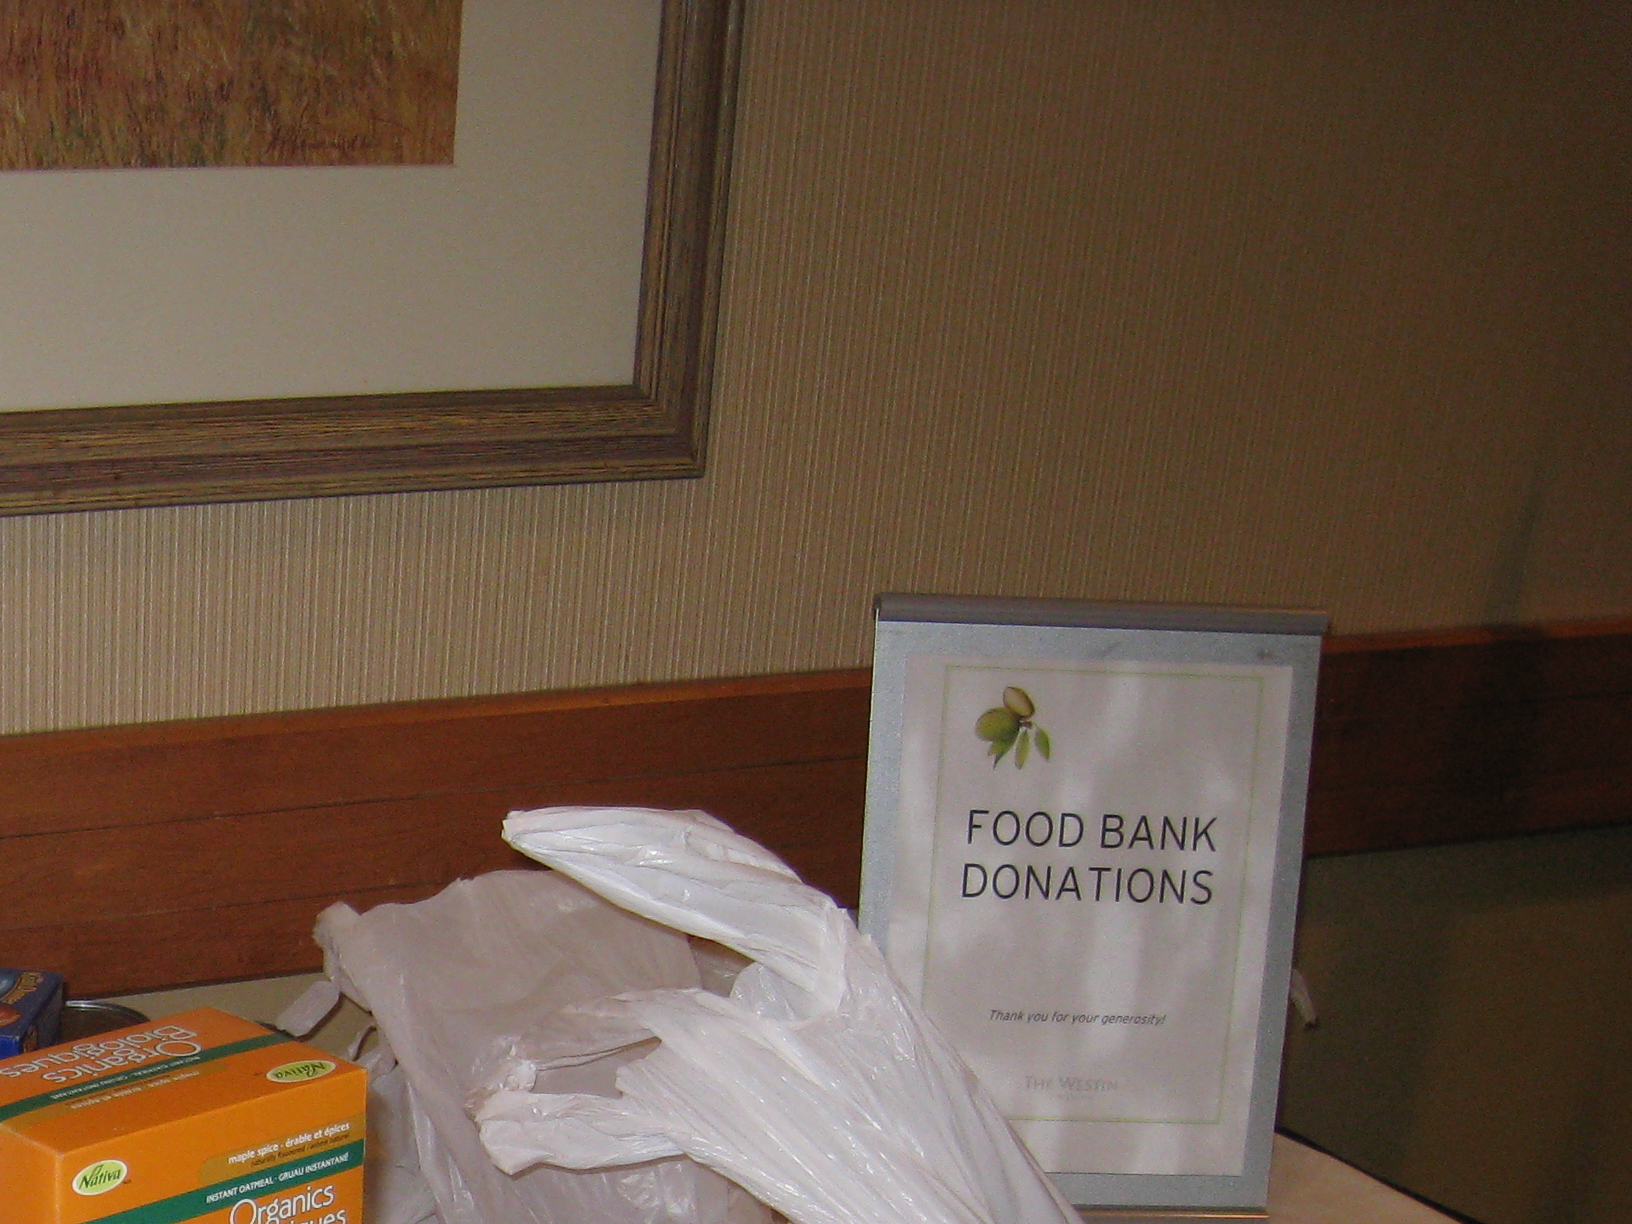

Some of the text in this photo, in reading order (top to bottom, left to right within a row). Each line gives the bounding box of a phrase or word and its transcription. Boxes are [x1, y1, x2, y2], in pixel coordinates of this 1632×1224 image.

[966, 809, 1218, 853] FOOD BANK
[961, 862, 1214, 905] DONATIONS
[988, 1009, 1167, 1028] Thank you for your generosity!
[41, 1039, 204, 1084] Organics
[228, 1149, 255, 1165] maple
[256, 1143, 279, 1158] spice
[285, 1132, 312, 1148] érable
[324, 1122, 351, 1139] épices
[78, 1164, 122, 1190] Nativa
[205, 1152, 350, 1204] INSTANT OATMEAL GRUAU INSTANTANÉ
